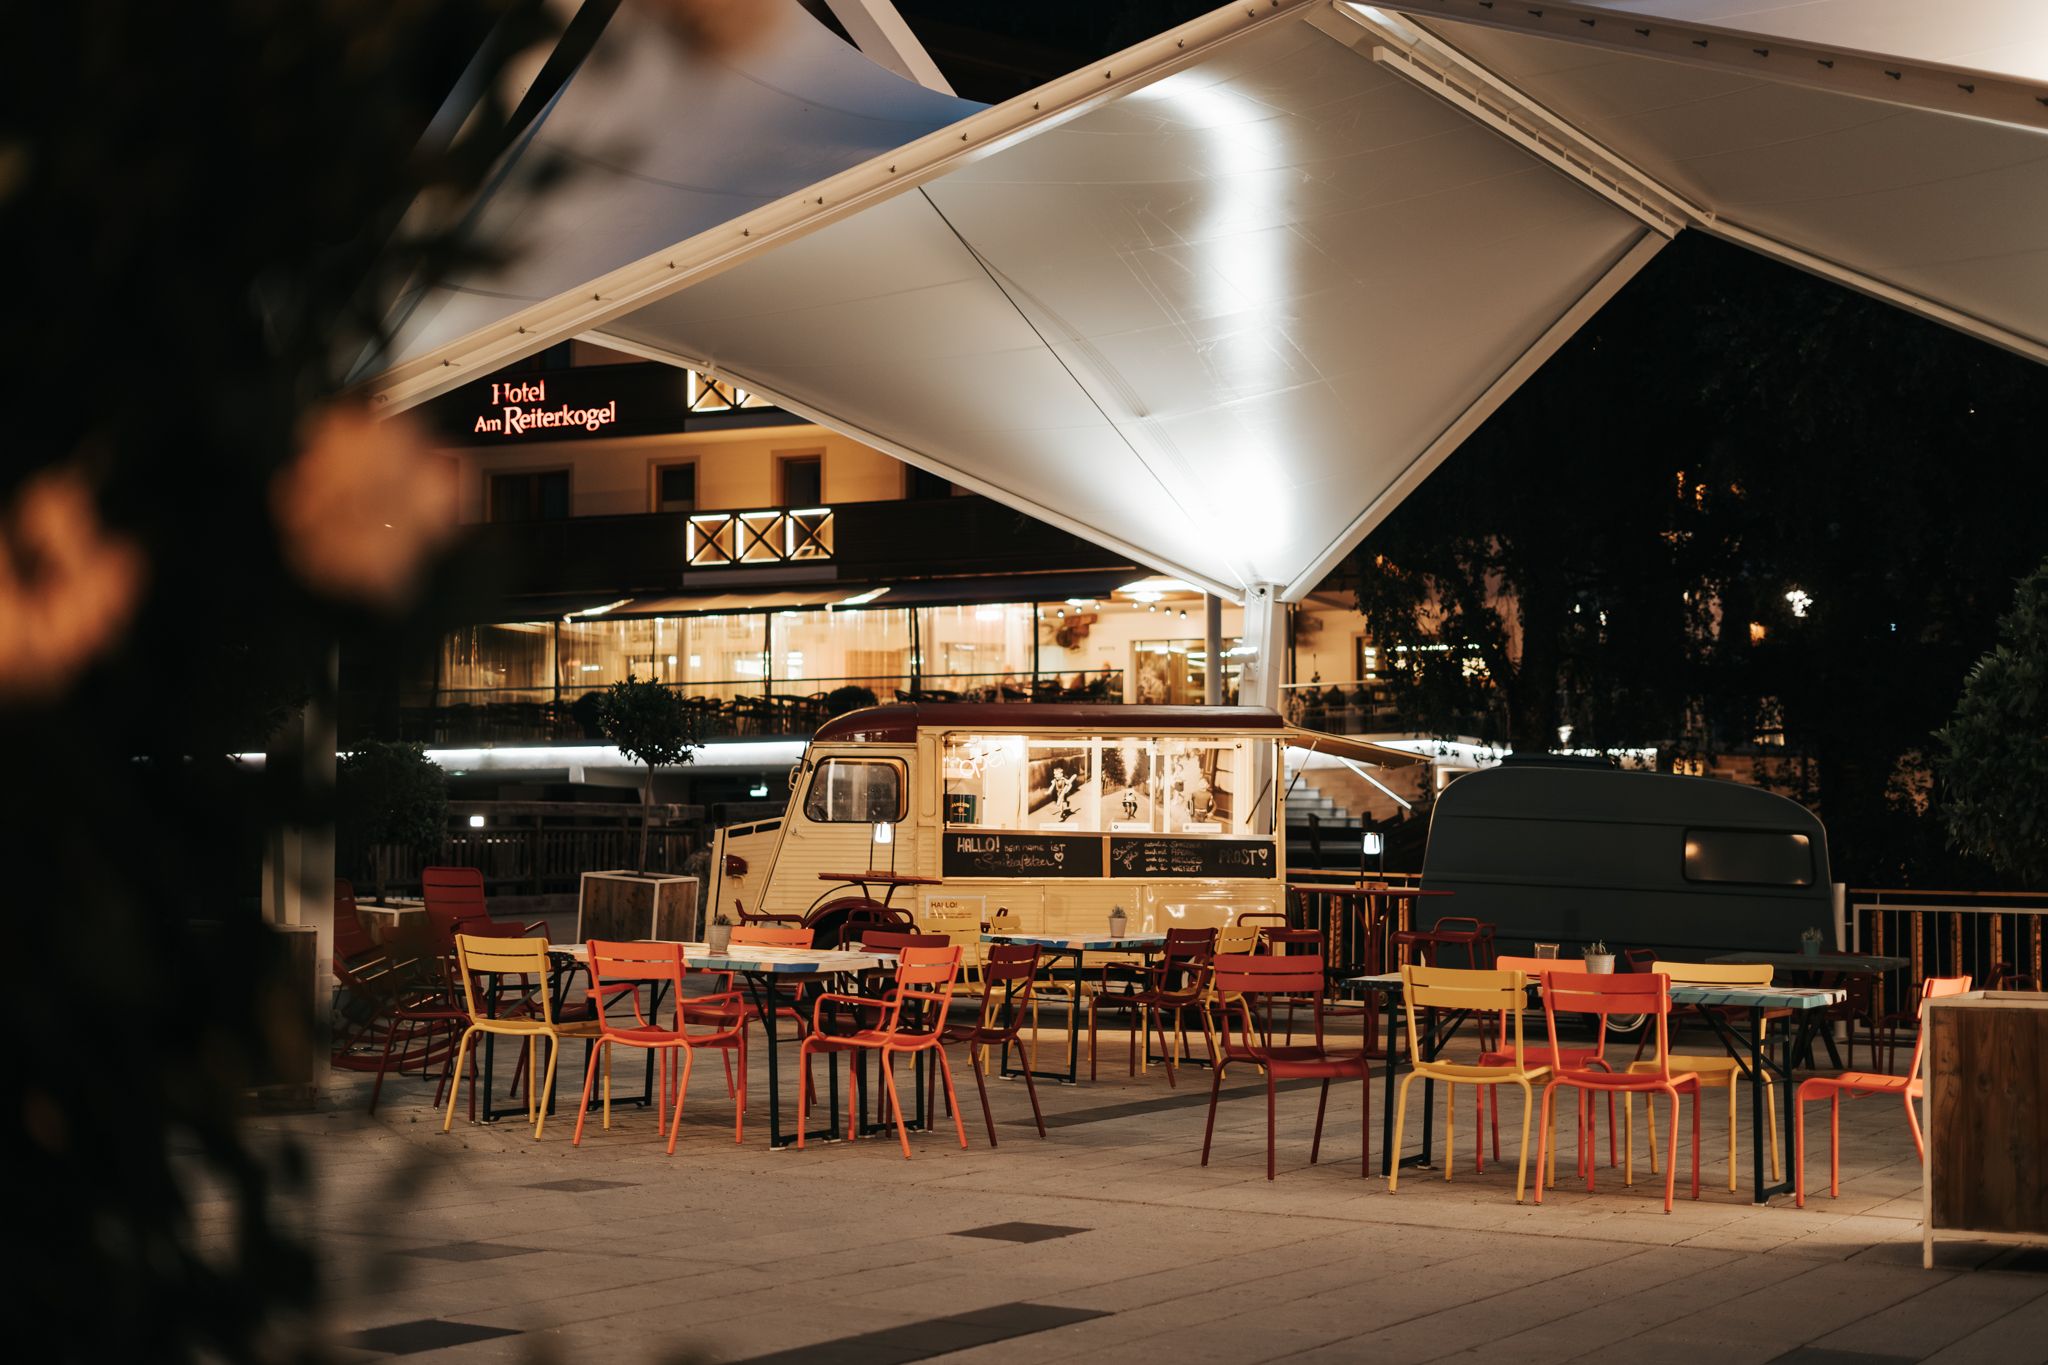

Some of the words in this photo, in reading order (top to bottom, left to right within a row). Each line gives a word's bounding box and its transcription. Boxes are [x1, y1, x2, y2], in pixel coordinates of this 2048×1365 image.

[491, 379, 545, 405] Hotel
[474, 416, 501, 433] Am
[503, 400, 616, 435] Reiterkogel
[957, 836, 1000, 853] HALLO!
